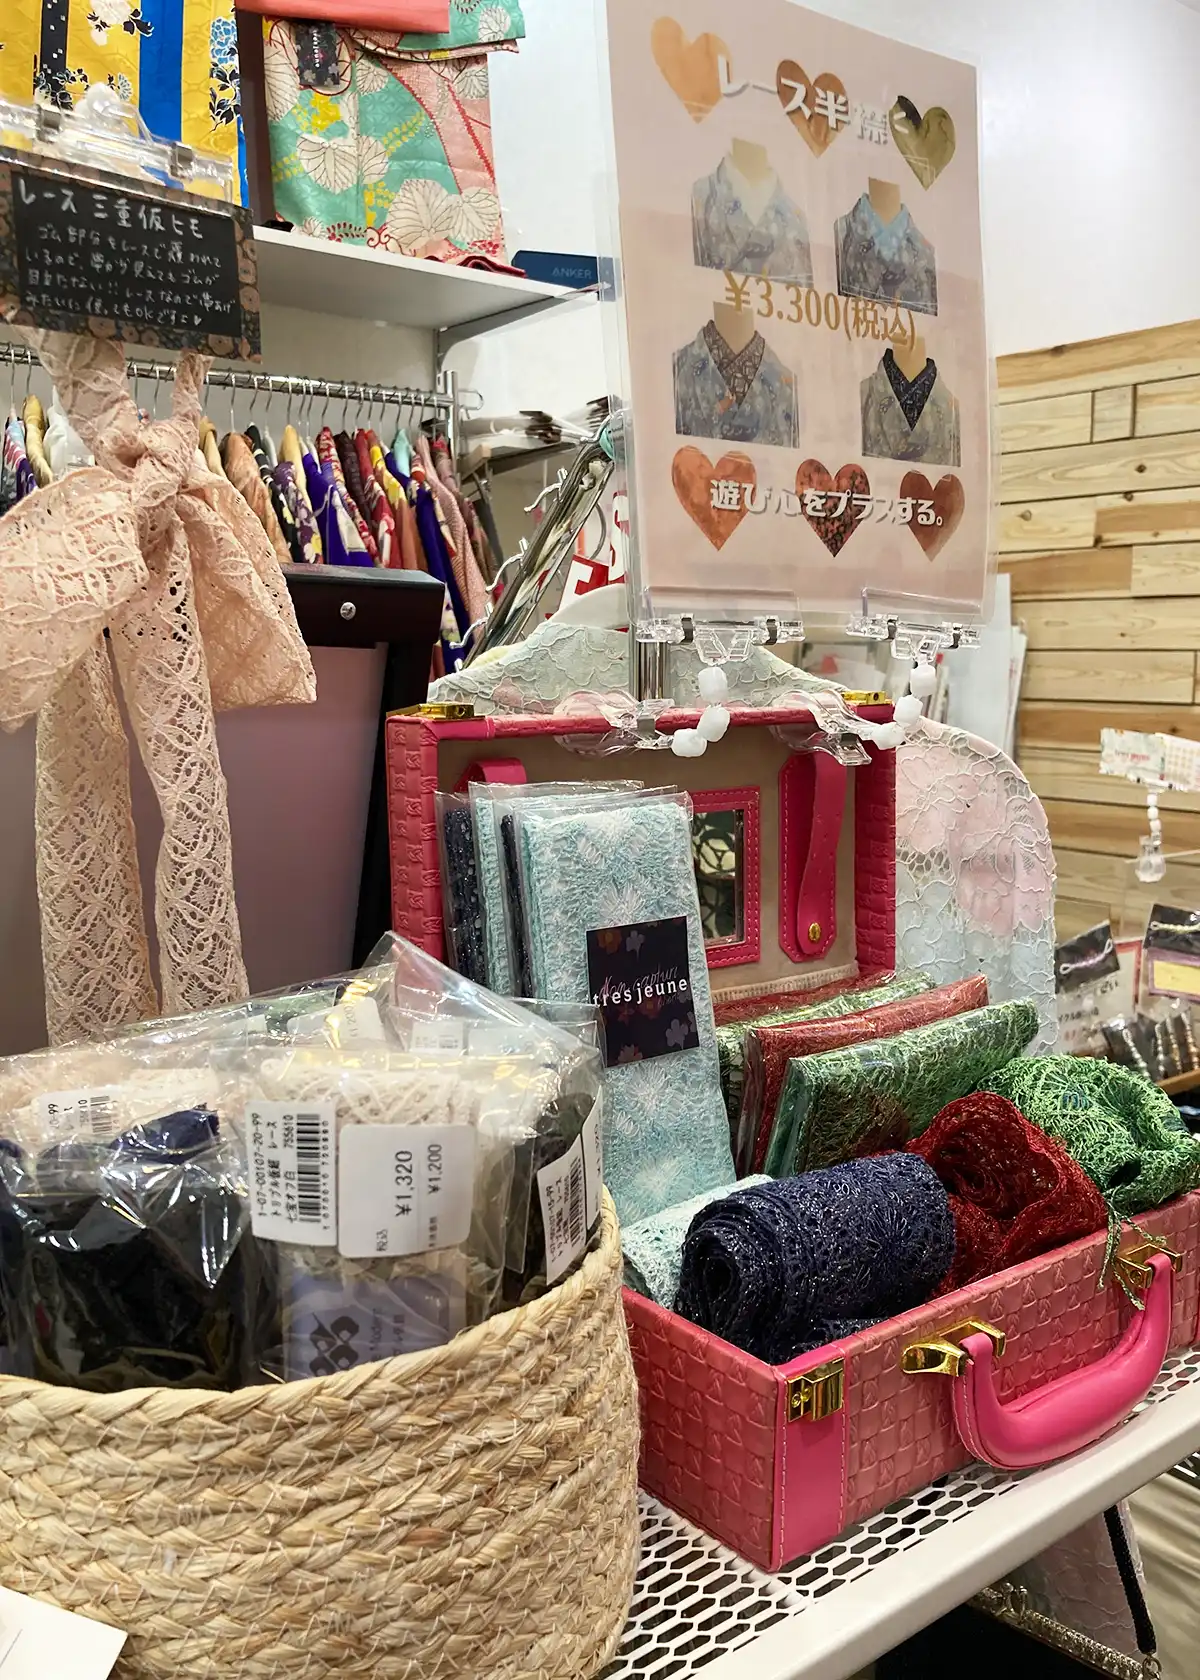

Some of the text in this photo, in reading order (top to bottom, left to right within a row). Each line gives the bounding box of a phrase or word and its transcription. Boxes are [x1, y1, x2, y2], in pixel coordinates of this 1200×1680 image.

[551, 266, 592, 280] ANKER
[709, 478, 944, 528] 遊び心をプラスする。
[266, 1120, 278, 1149] レース
[251, 1112, 268, 1217] 1-07-00107-20-99
[394, 1149, 415, 1217] ¥1,320
[427, 1143, 443, 1195] ¥1,200
